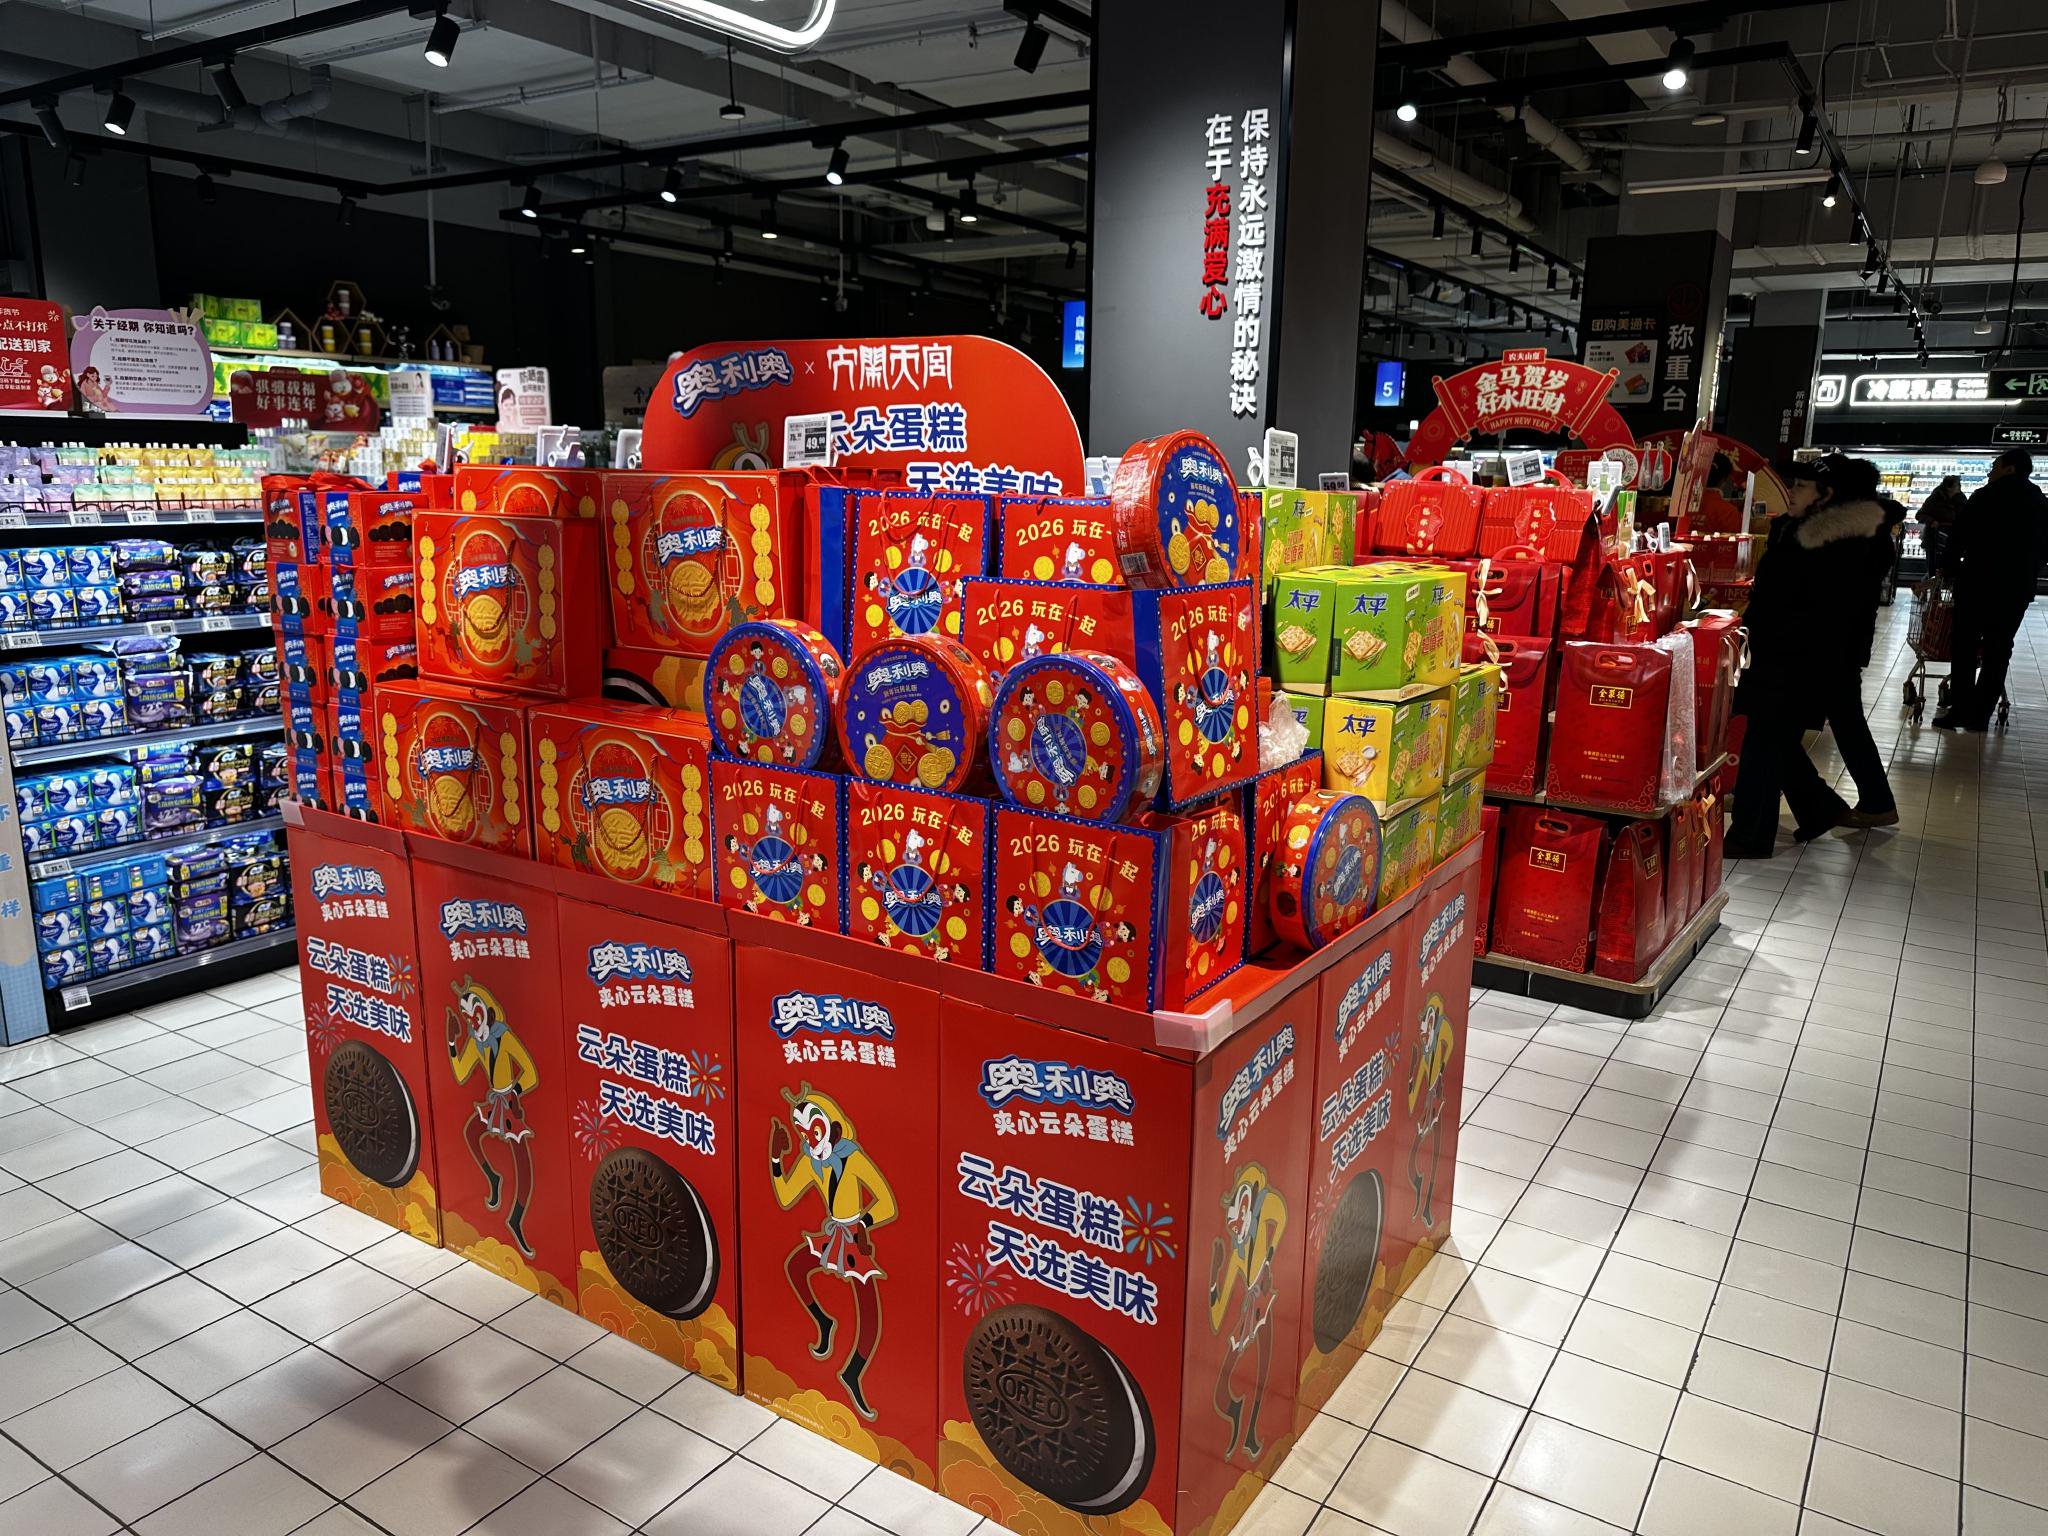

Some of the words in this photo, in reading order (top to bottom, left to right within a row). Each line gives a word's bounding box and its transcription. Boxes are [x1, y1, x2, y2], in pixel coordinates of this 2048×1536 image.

[1200, 113, 1233, 319] 在于充满爱心
[1229, 108, 1270, 416] 保持永远激情的秘诀
[0, 319, 48, 333] 点不打烊
[93, 318, 139, 332] 关于经期
[675, 349, 794, 413] 奥利奥
[1474, 365, 1569, 395] 金马贺岁
[1662, 323, 1695, 412] 称重台
[1383, 381, 1393, 397] 5
[1476, 389, 1566, 416] 好水旺财
[1490, 418, 1513, 430] HAPPY
[1514, 417, 1532, 425] NEW
[1532, 418, 1550, 430] YEAR
[1180, 457, 1223, 484] 奥利奥
[657, 527, 723, 563] 奥利奥
[1016, 519, 1064, 546] 2026
[455, 563, 516, 596] 奥利奥
[976, 599, 1024, 625] 2026
[1207, 605, 1247, 632] 玩在起
[1282, 589, 1320, 613] 太平
[1348, 593, 1388, 617] 太平
[866, 661, 929, 692] 奥利奥
[1338, 714, 1376, 737] 太平
[420, 749, 478, 775] 奥利奥
[584, 778, 656, 808] 奥利奥
[723, 780, 763, 801] 2026
[769, 782, 827, 820] 玩在一起
[1263, 783, 1287, 816] 206
[860, 803, 905, 826] 2026
[911, 806, 974, 847] 玩在一起
[1010, 834, 1060, 857] 2026
[1067, 838, 1139, 884] 玩在一起
[312, 864, 386, 898] 奥利奥
[320, 899, 389, 922] 夹心云朵蛋糕
[442, 899, 527, 936] 奥利奥
[307, 936, 393, 994] 云朵蛋糕
[449, 937, 531, 961] 夹心云朵蛋糕
[589, 943, 692, 981] 奥利奥
[598, 985, 695, 1009] 夹心云朵蛋糕
[1336, 952, 1391, 1034] 奥利奥
[326, 983, 412, 1043] 天选美味
[775, 994, 895, 1037] 奥利奥
[1339, 980, 1392, 1063] 夹心云朵蛋糕
[577, 1024, 692, 1097] 云朵蛋糕
[782, 1039, 896, 1068] 夹心云朵蛋糕
[985, 1058, 1132, 1109] 奥利奥
[1219, 1025, 1295, 1130] 奥利奥
[1320, 1049, 1384, 1141] 云朵蛋糕
[600, 1080, 716, 1155] 天选美味
[992, 1110, 1135, 1146] 夹心云朵蛋糕
[1223, 1059, 1295, 1163] 夹心云朵蛋糕
[1330, 1089, 1391, 1183] 天选美味
[957, 1151, 1124, 1253] 云朵蛋糕
[614, 1207, 662, 1243] OREO
[987, 1219, 1158, 1325] 天选美味
[1001, 1374, 1064, 1421] OREO
